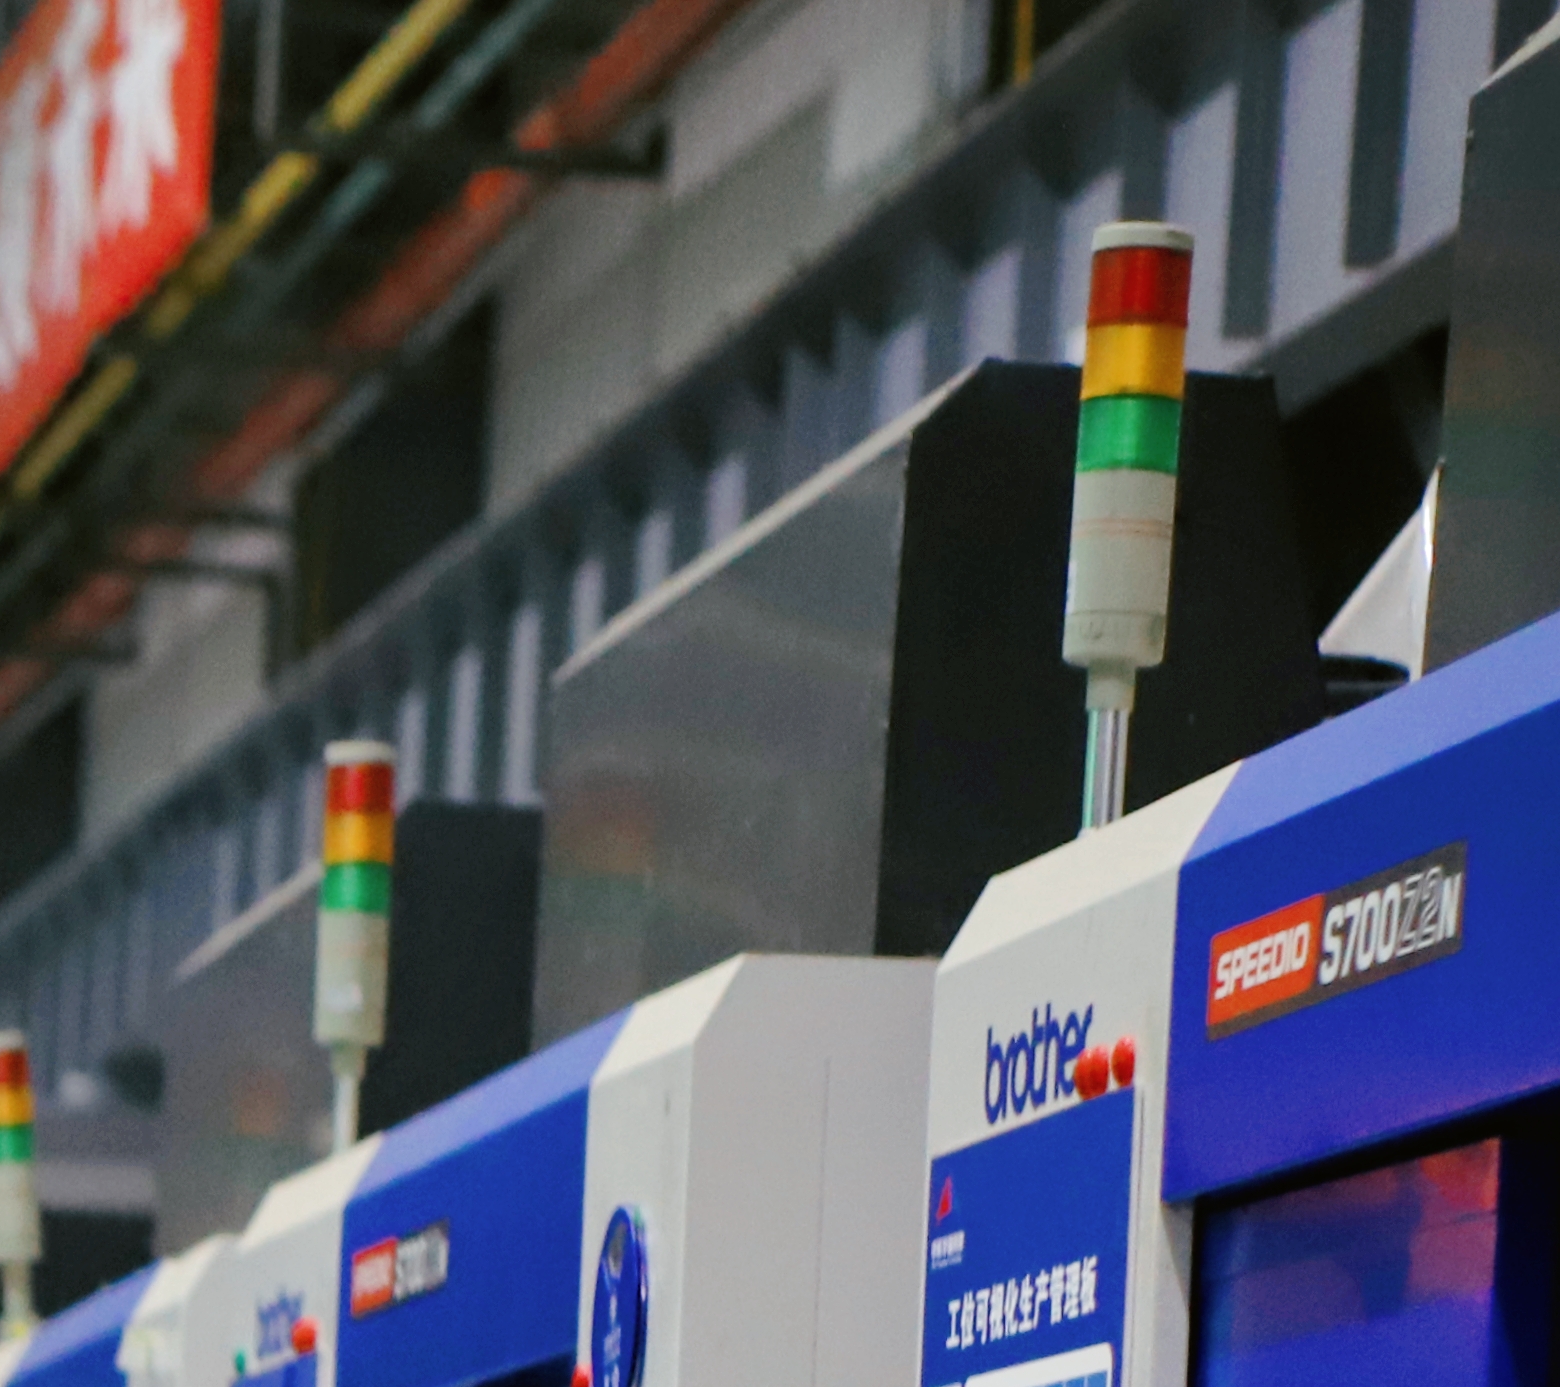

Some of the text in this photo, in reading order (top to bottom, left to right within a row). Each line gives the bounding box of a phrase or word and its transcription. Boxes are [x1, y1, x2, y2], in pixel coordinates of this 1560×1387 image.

[1214, 919, 1311, 999] SPEEDIO
[984, 1001, 1094, 1126] brother
[945, 1253, 1100, 1350] 工位可视化生产管理板
